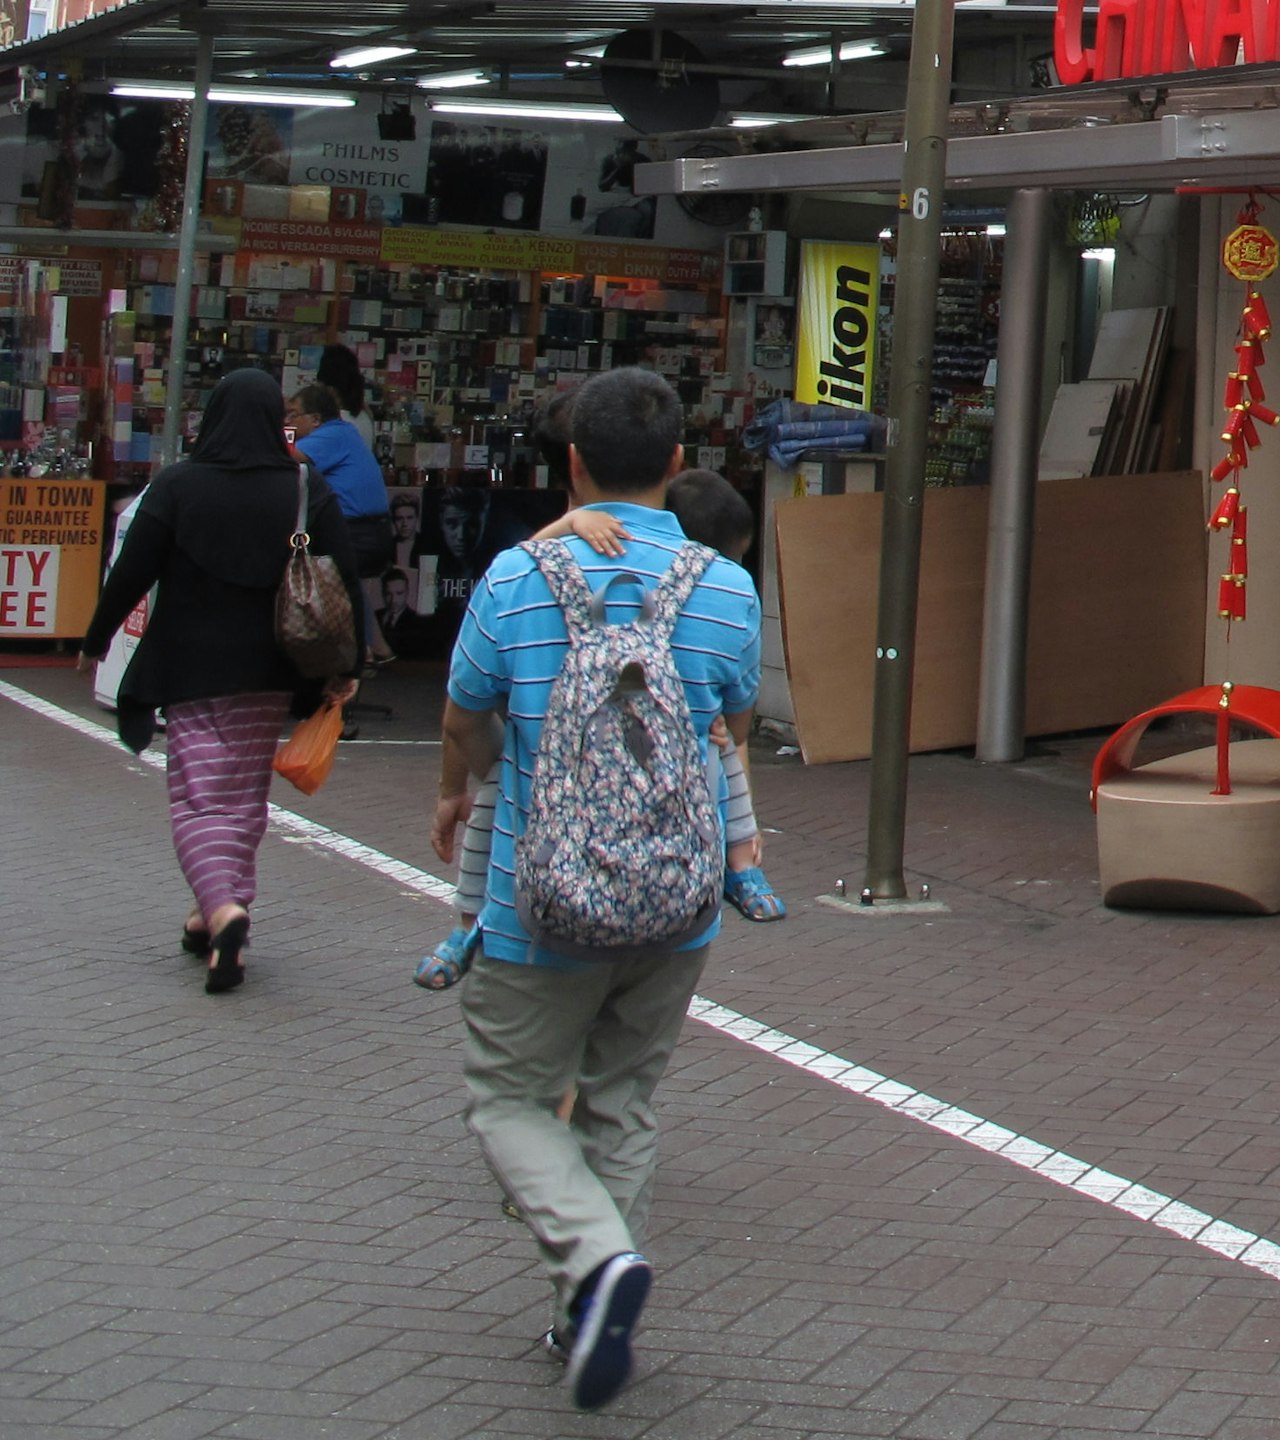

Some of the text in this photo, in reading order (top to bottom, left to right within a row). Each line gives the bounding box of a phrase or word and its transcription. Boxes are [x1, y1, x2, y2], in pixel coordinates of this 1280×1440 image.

[321, 142, 400, 162] PHILMS
[305, 166, 411, 189] COSMETIC
[912, 187, 930, 220] 6
[280, 223, 332, 237] ESCADA
[333, 227, 380, 240] BVLGARI
[280, 241, 329, 254] VERSACE
[529, 240, 574, 254] KENZO
[624, 263, 663, 278] DKNY
[817, 264, 871, 409] ikon
[9, 486, 94, 506] IN TOWN
[6, 510, 90, 526] GUARANTEE
[22, 529, 98, 545] PERFUMES
[2, 551, 50, 586] TY
[442, 578, 468, 597] THE
